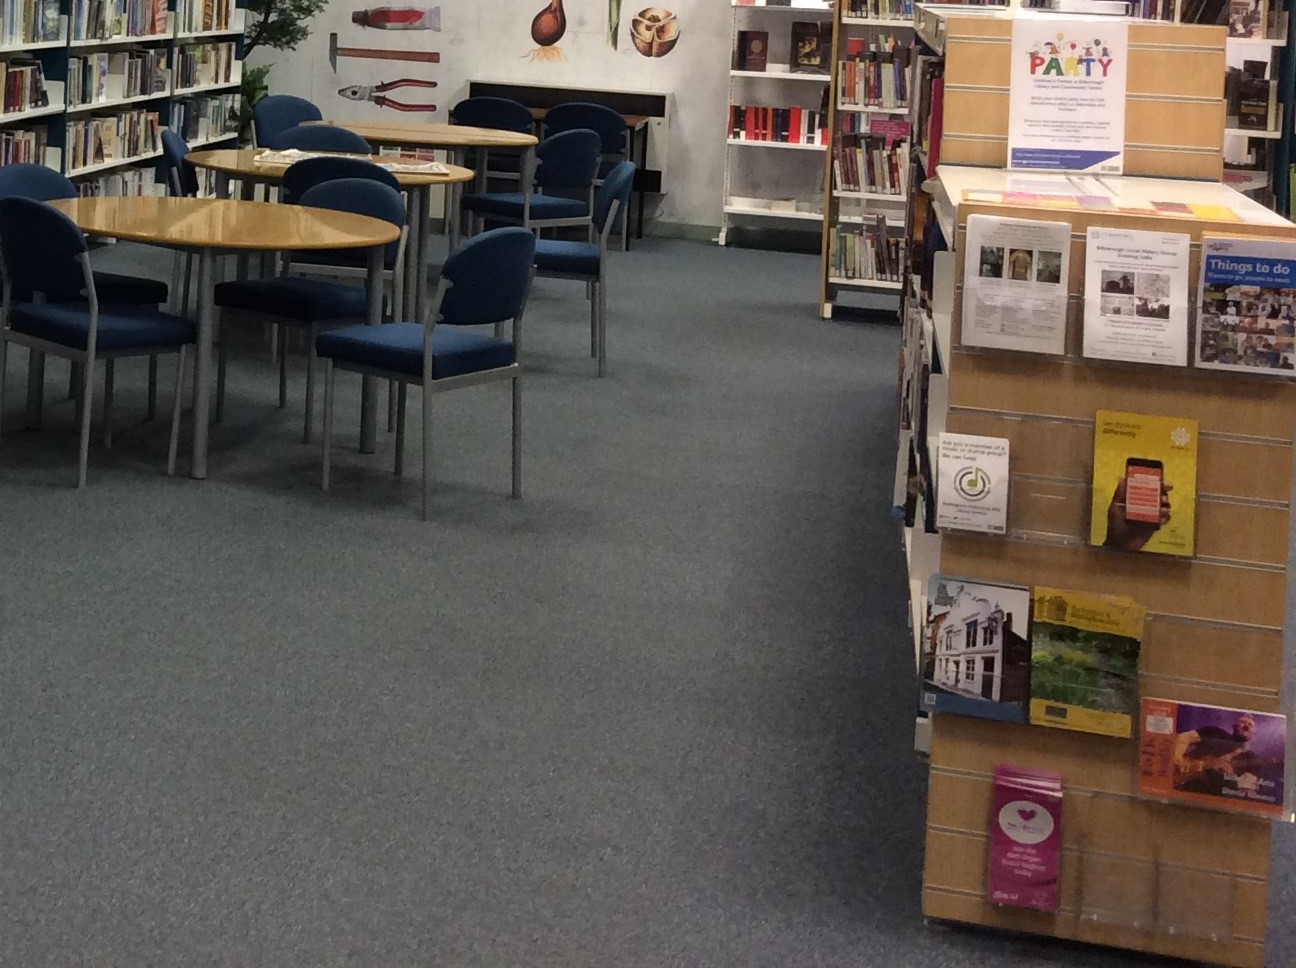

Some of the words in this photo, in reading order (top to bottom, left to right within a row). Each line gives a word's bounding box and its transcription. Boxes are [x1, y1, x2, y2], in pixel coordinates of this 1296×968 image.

[1030, 55, 1113, 77] PARTY
[1209, 258, 1253, 275] Things
[1256, 262, 1270, 273] to
[1273, 263, 1291, 275] do
